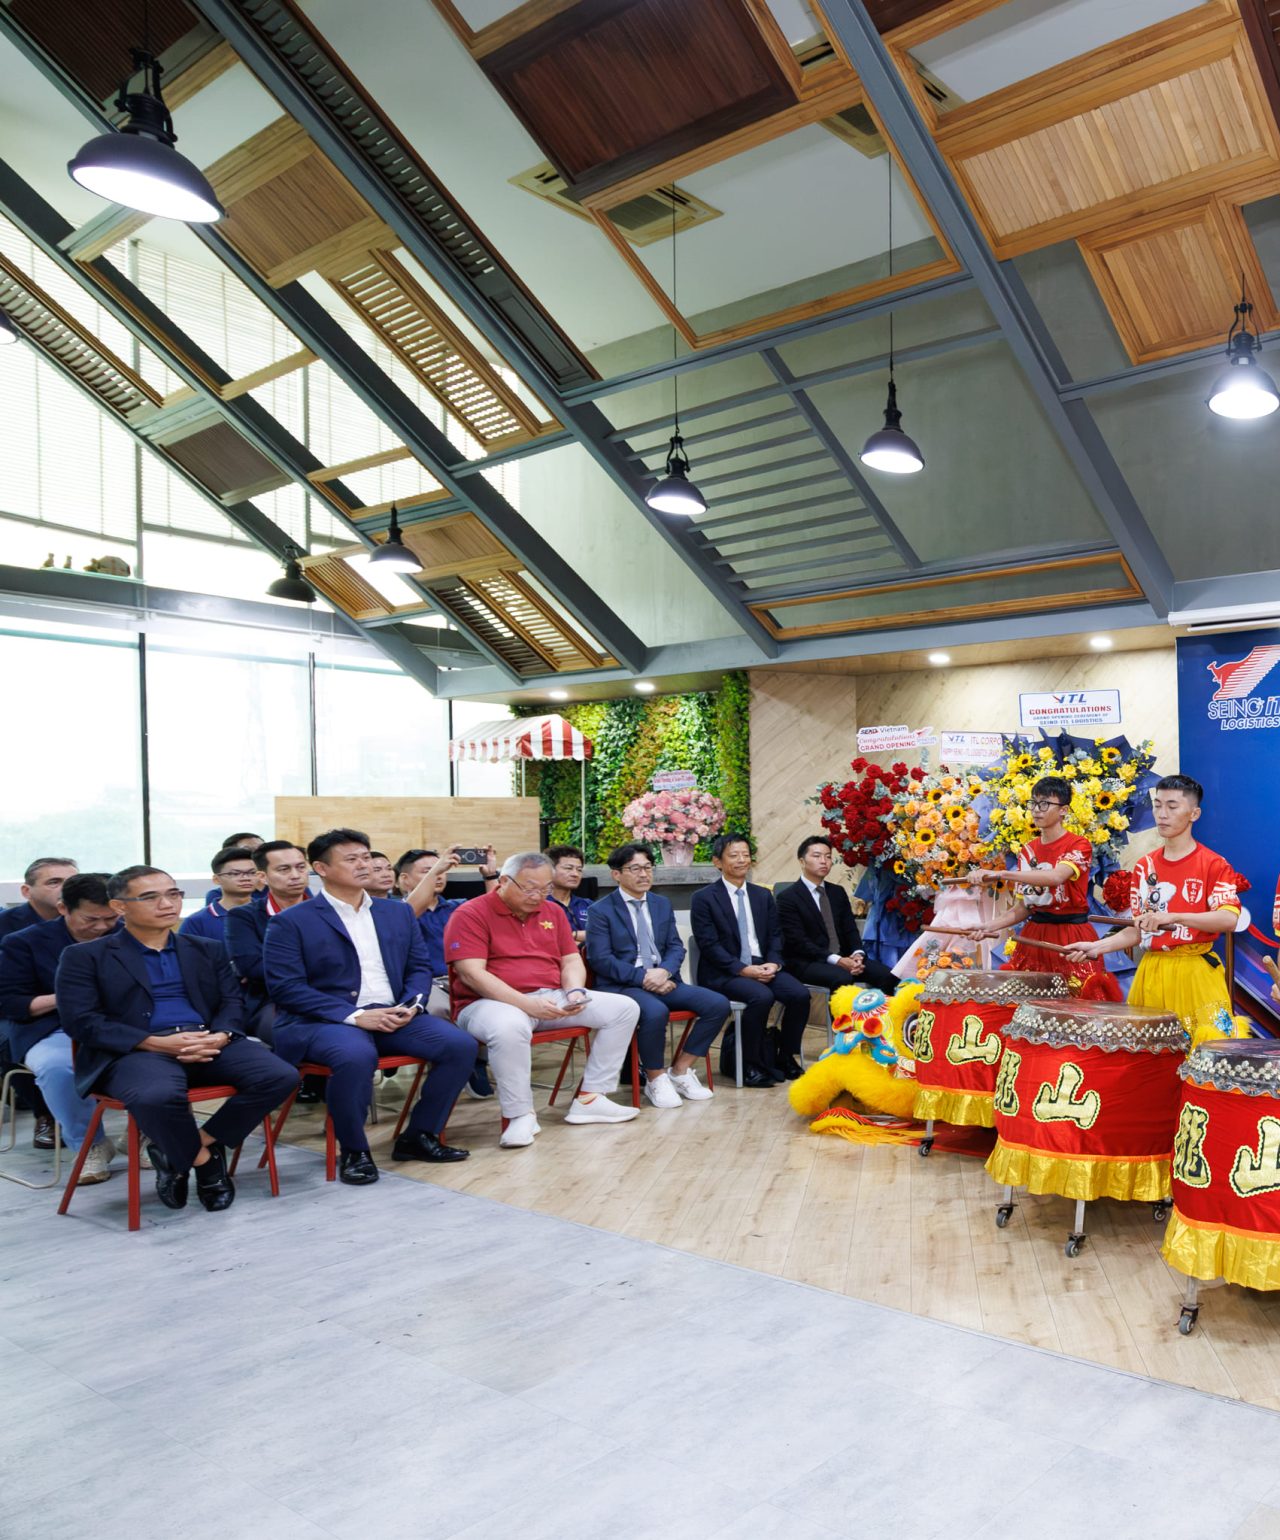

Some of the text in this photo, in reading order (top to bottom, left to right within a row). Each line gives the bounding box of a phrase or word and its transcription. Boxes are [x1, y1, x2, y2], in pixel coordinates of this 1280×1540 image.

[1029, 705, 1112, 716] CONGRATULATIONS
[1207, 697, 1265, 720] SEINO
[860, 741, 916, 751] GRAND OPENING
